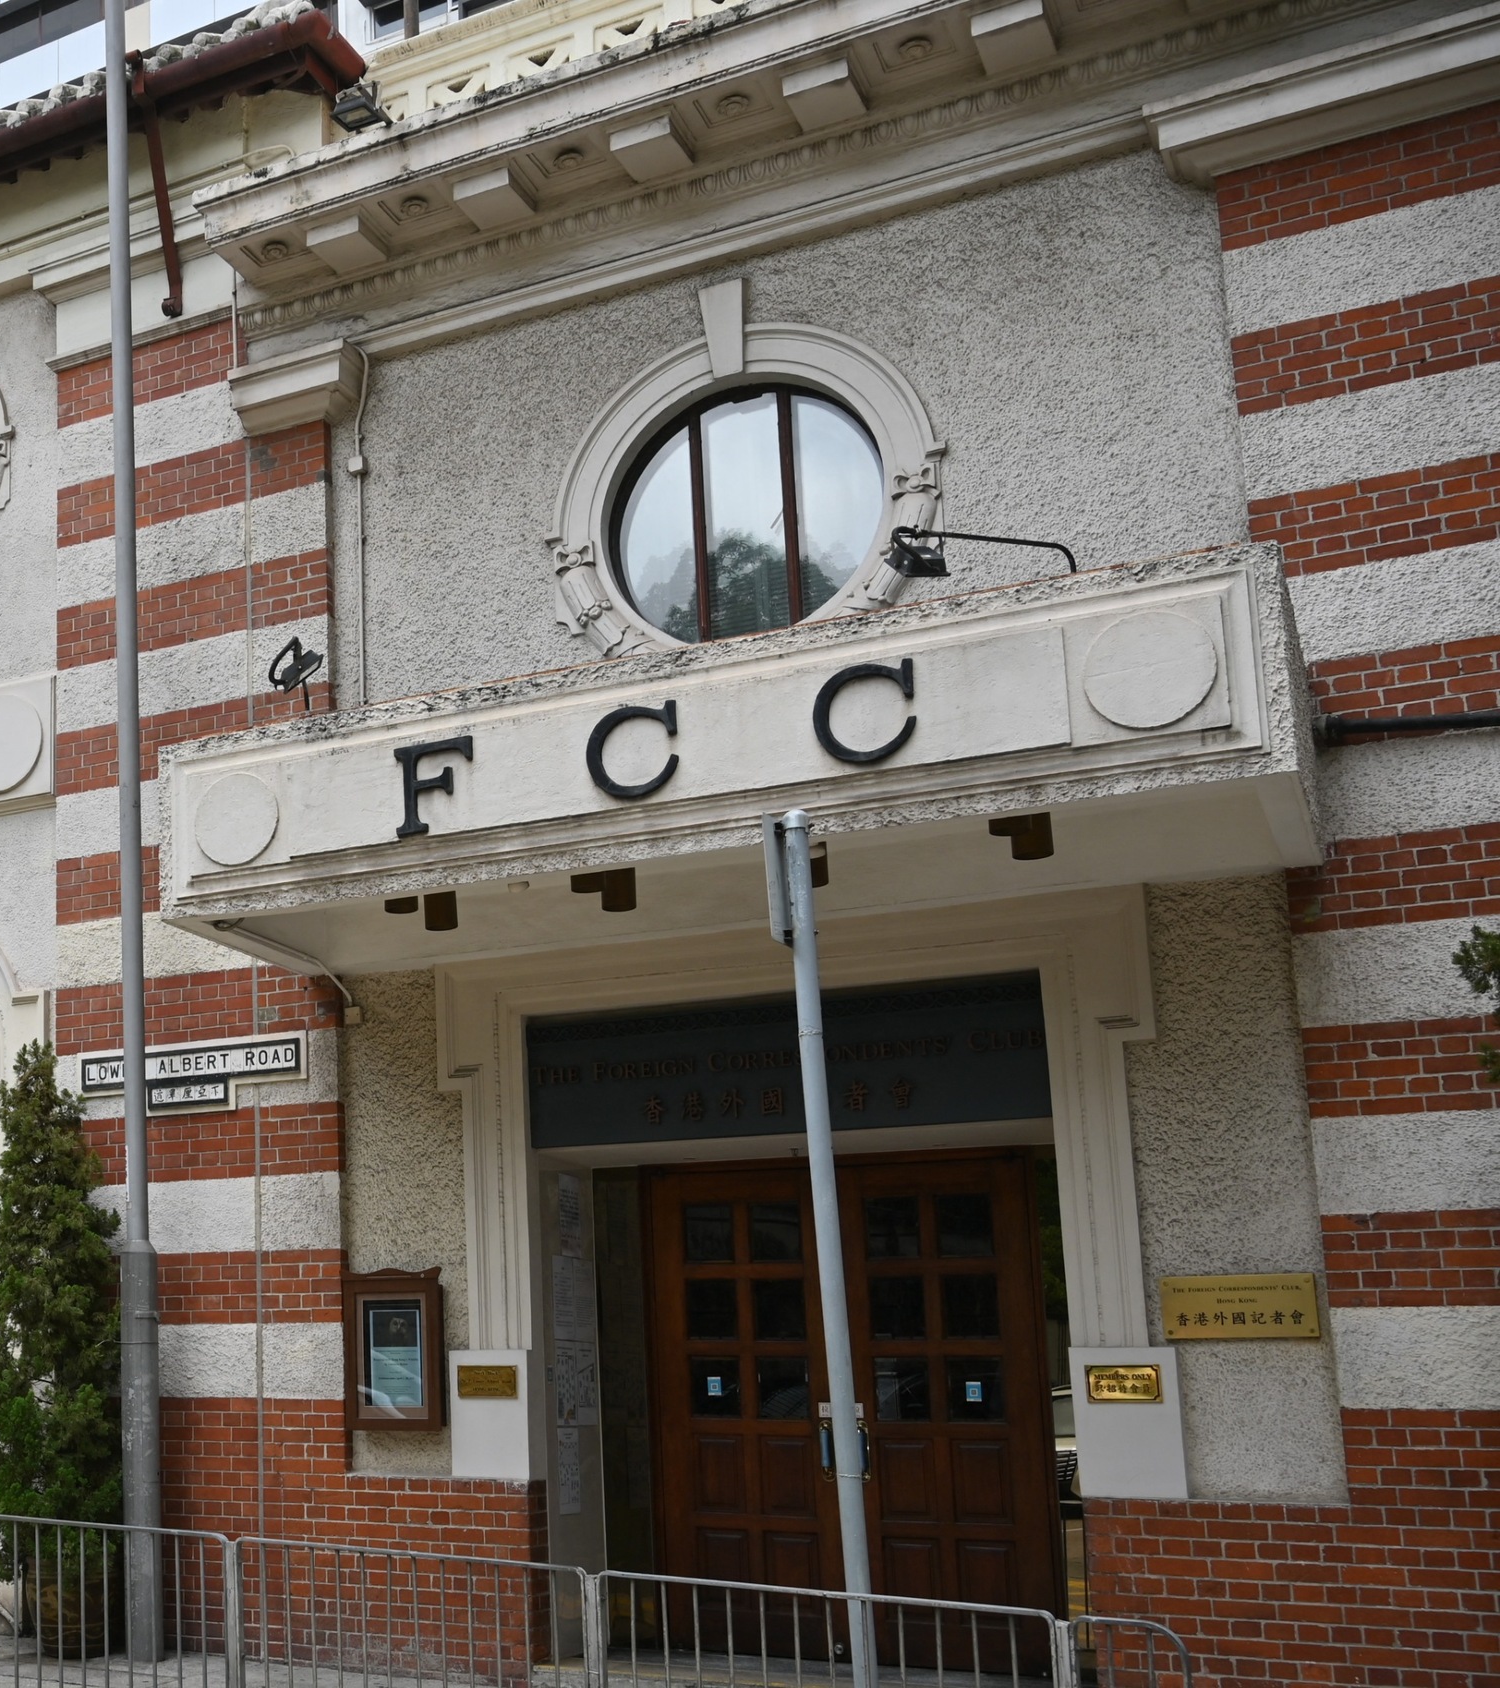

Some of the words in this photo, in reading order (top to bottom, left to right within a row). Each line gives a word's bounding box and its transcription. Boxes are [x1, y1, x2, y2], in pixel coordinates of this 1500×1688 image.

[87, 1063, 125, 1082] LOW
[158, 1053, 230, 1075] ALBERT
[245, 1047, 295, 1067] ROAD
[532, 1065, 581, 1087] THE
[592, 1056, 696, 1082] FOREIGN
[966, 1029, 1043, 1053] CLUB
[641, 1076, 916, 1125] 香港外國者會
[1218, 1285, 1279, 1293] CORRESPONDENTS'
[1176, 1309, 1306, 1327] 香港外國記者會
[1094, 1373, 1130, 1381] MEMBERS
[1131, 1373, 1152, 1381] ONLY
